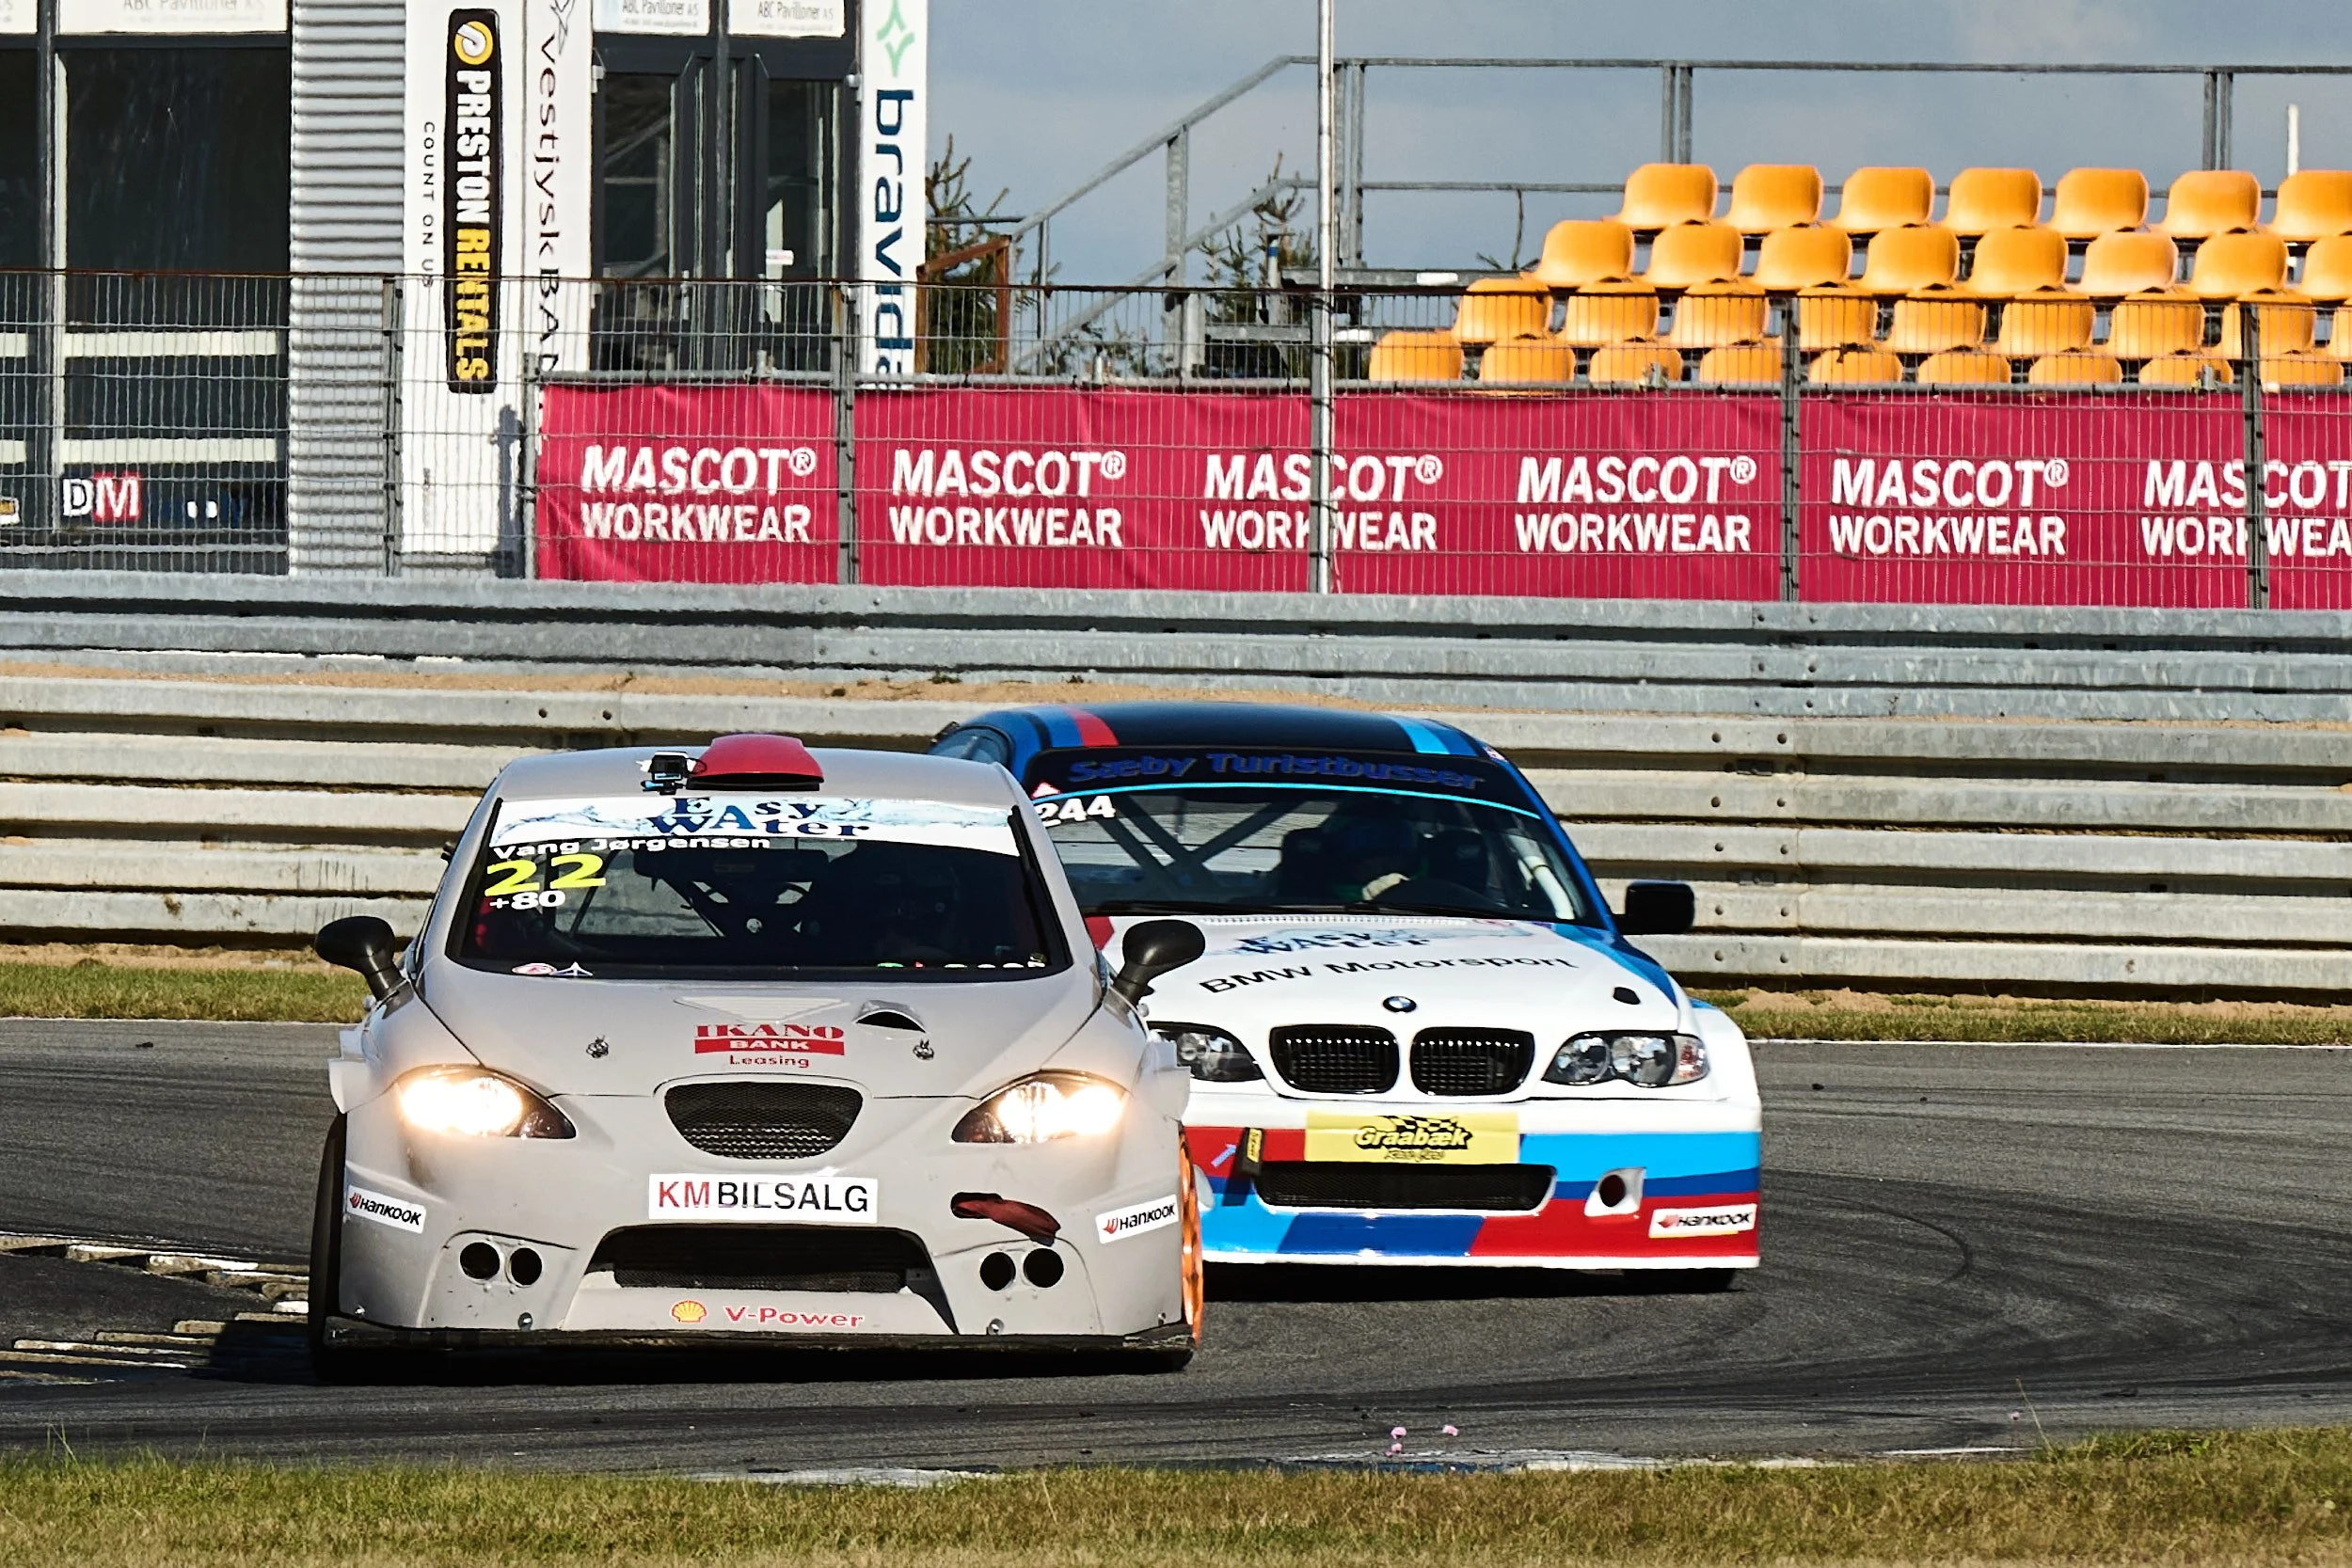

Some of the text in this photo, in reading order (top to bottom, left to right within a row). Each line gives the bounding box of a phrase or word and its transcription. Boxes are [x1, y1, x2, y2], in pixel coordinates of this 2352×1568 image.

[757, 1, 774, 18] ABC
[421, 121, 436, 201] COUNT
[421, 214, 435, 245] ON
[455, 70, 491, 380] PRESTON RENTALS
[580, 501, 811, 544] WORKWEAR
[890, 505, 1123, 547] WORKWEAR
[1515, 512, 1751, 554] WORKWEAR
[1830, 514, 2067, 557] WORKWEAR
[1070, 752, 1486, 790] Sæby Turistbusser
[1034, 796, 1116, 828] 244
[493, 836, 771, 862] Vang Jørgensen
[485, 853, 607, 895] 22
[488, 890, 566, 911] +80
[1199, 957, 1580, 995] BMW Motorsport
[695, 1023, 845, 1039] IKANO
[729, 1039, 810, 1051] BANK
[729, 1054, 810, 1069] Leasing
[1354, 1125, 1471, 1150] Graabæk
[724, 1306, 864, 1328] V-Power
